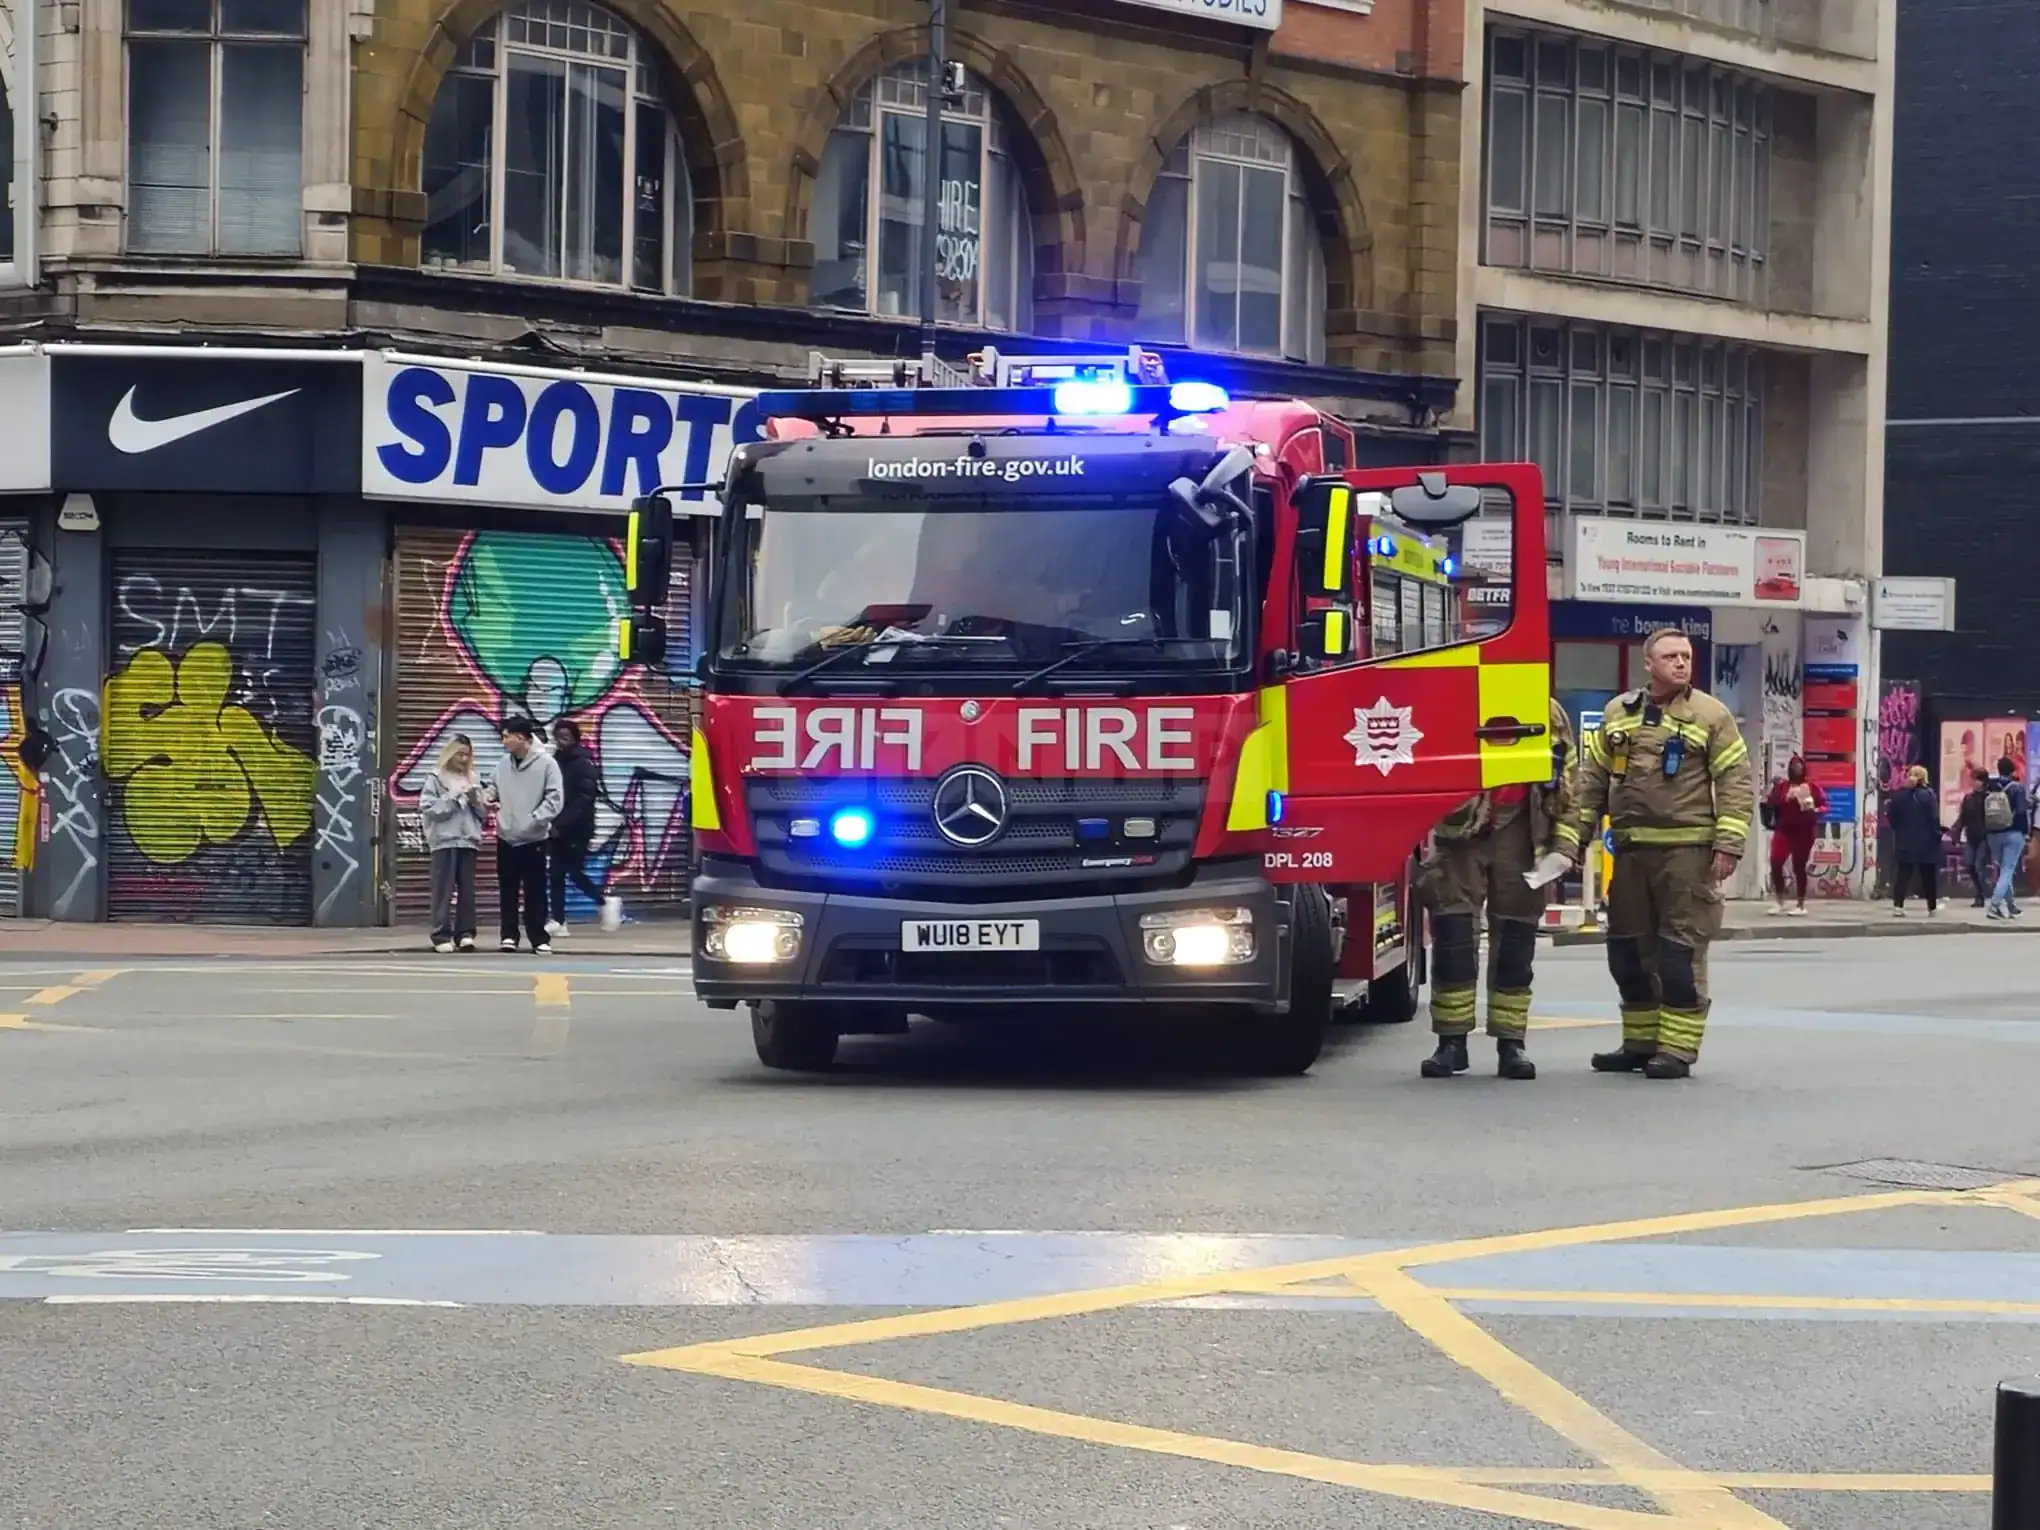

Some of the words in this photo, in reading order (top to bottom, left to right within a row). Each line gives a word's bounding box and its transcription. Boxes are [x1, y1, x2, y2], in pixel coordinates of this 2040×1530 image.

[868, 455, 1084, 481] london-fire.gov.uk
[1626, 531, 1658, 546] Rooms
[1661, 534, 1671, 546] to
[1674, 534, 1695, 548] Rent
[1697, 536, 1706, 549] in
[1681, 617, 1710, 640] king
[1017, 707, 1195, 771] FIRE
[1264, 852, 1299, 868] DPL
[1302, 852, 1333, 868] 208
[916, 924, 970, 947] WU18
[977, 923, 1025, 946] EYT
